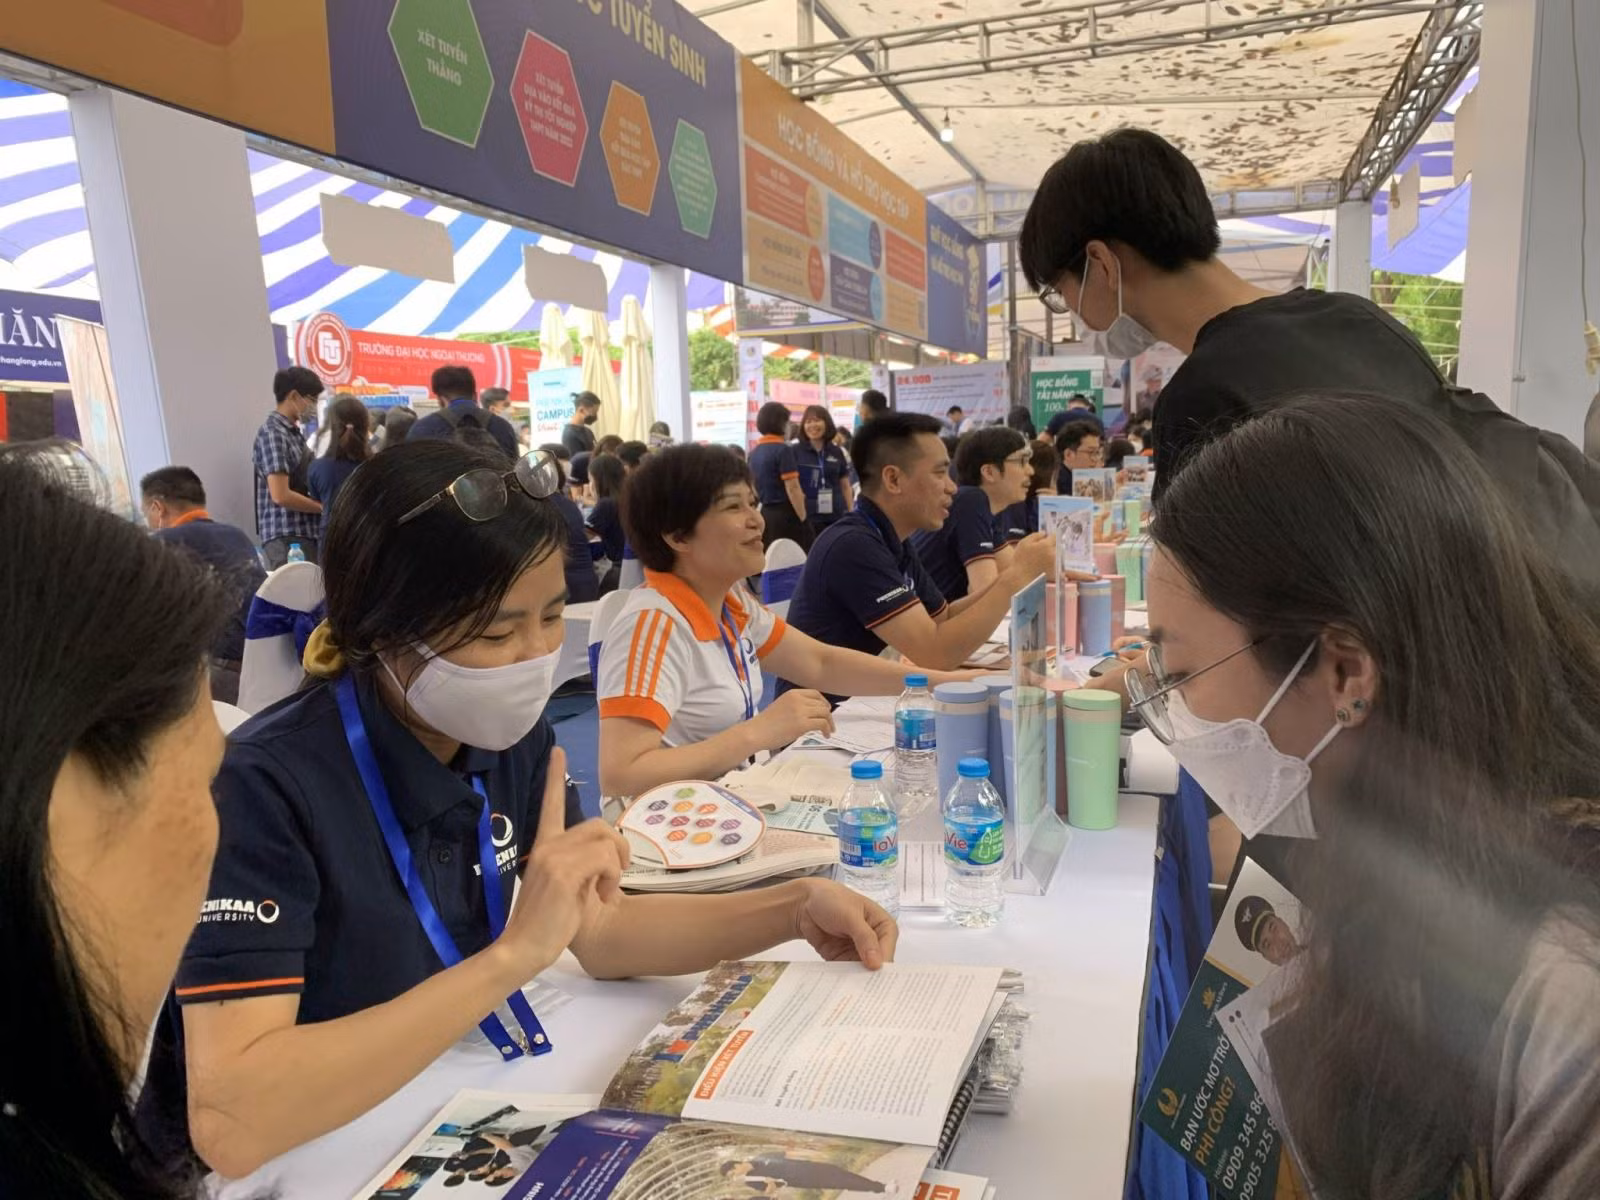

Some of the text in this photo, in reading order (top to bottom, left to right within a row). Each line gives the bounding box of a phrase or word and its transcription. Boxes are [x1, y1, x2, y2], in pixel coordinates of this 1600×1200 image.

[417, 28, 435, 49] XÉT
[669, 33, 706, 88] SINH
[0, 307, 57, 349] ĂN
[944, 832, 967, 849] Vie
[1180, 1117, 1200, 1151] BẠN
[1192, 1085, 1212, 1119] ƯỚC
[1204, 1062, 1221, 1090] MƠ
[1195, 1075, 1236, 1166] PHI CÔNG?
[1222, 1145, 1245, 1190] 0909
[1237, 1112, 1257, 1147] 345
[1239, 1161, 1262, 1200] 0905
[1255, 1128, 1274, 1163] 325
